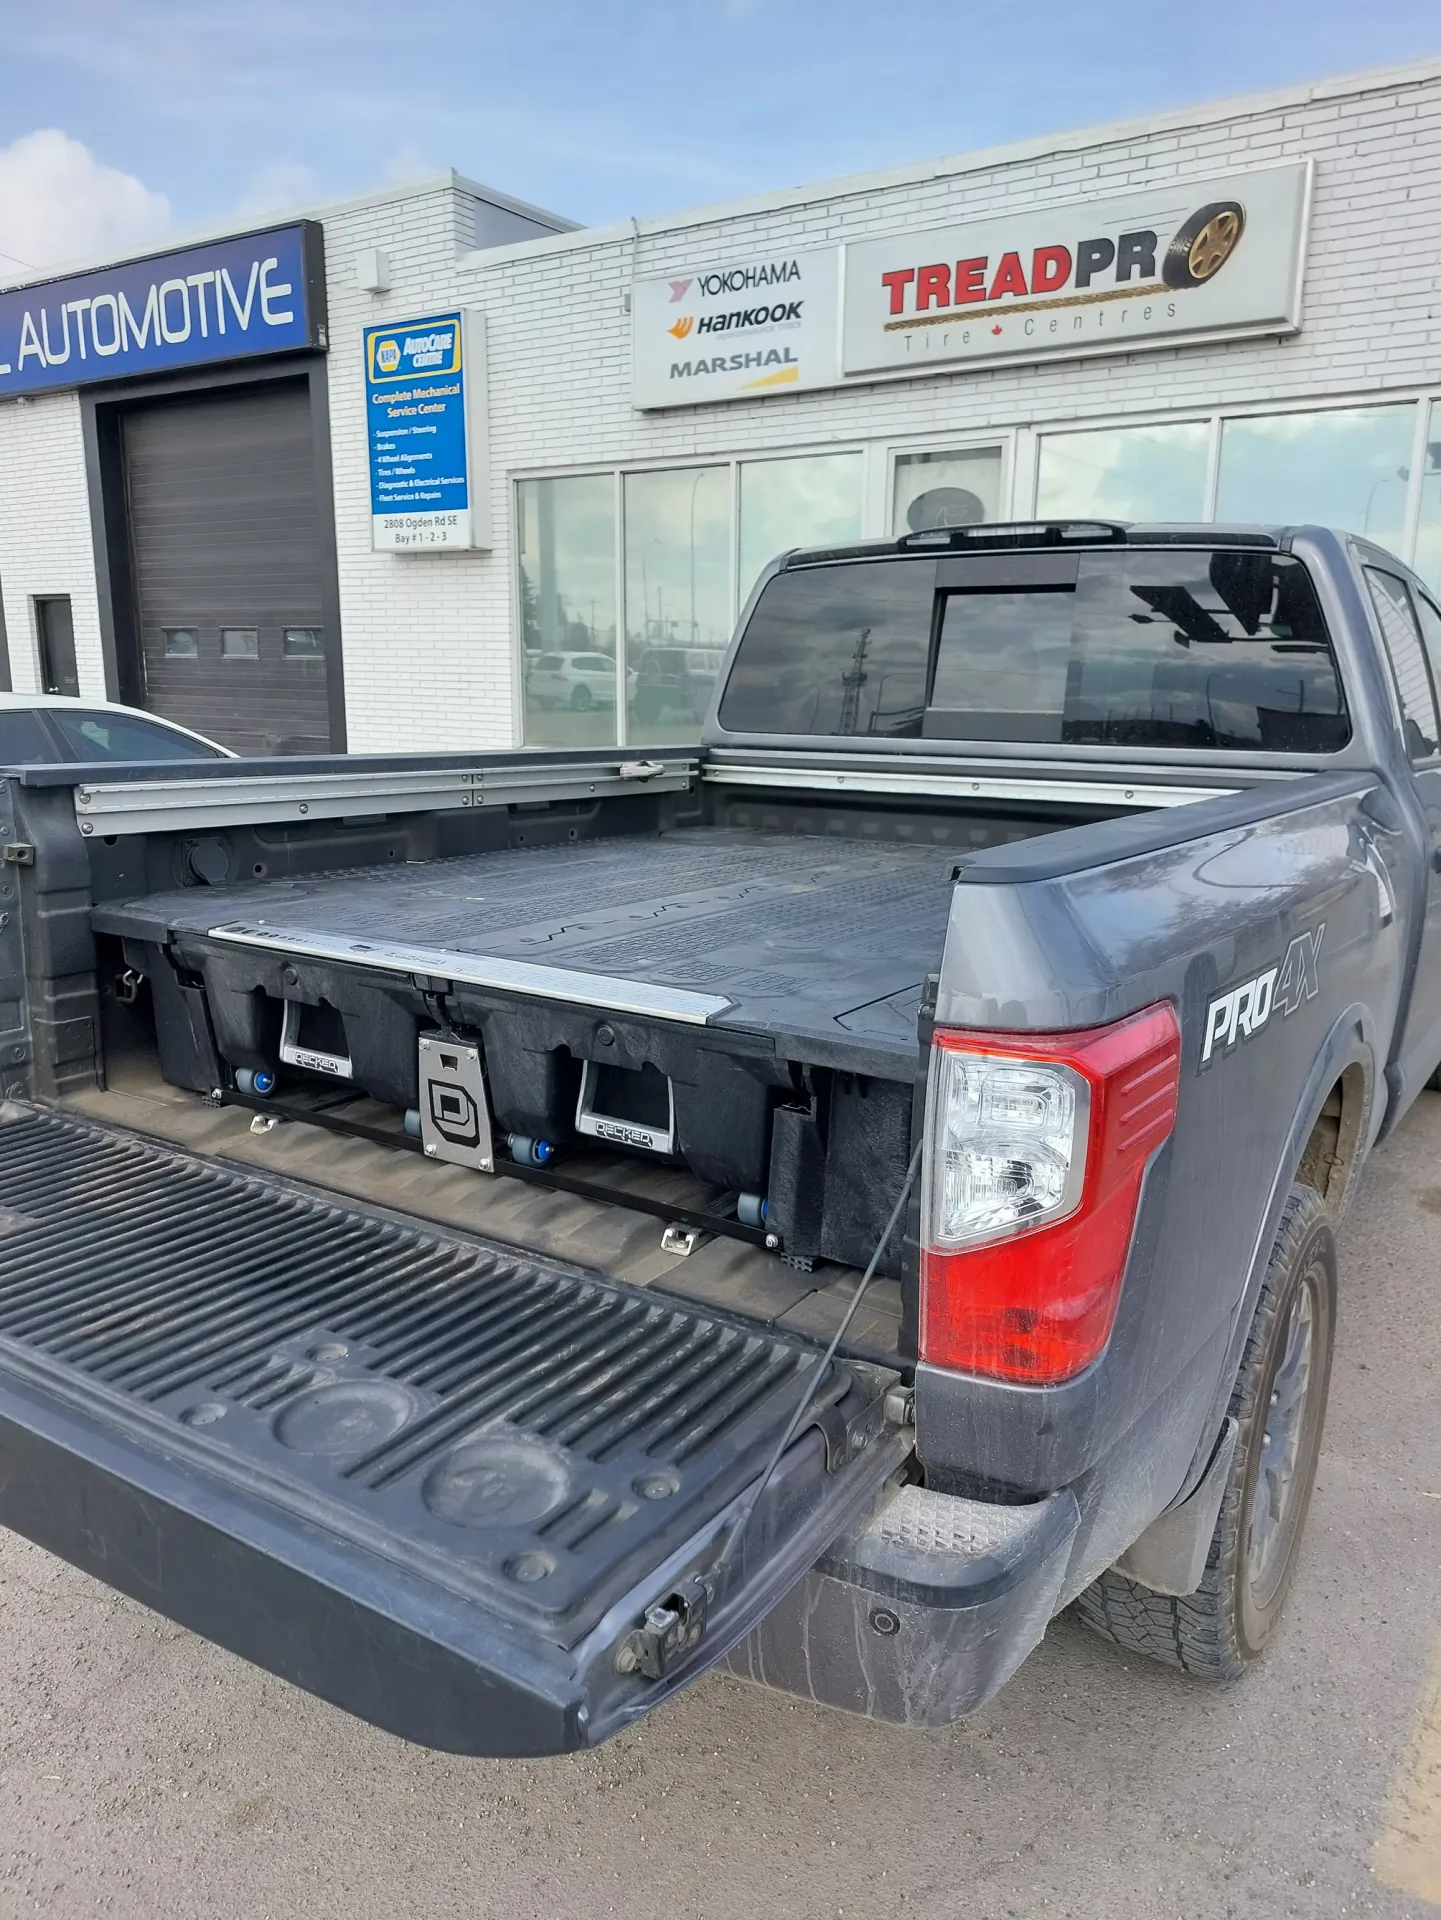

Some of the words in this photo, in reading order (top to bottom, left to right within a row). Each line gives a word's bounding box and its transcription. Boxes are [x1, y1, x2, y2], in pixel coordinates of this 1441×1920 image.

[697, 259, 801, 297] YOKOHAMA
[17, 257, 294, 372] AUTOMOTIVE
[903, 329, 970, 352] Tire
[1024, 302, 1176, 336] Centres
[381, 348, 397, 364] NAPA
[670, 347, 798, 379] MARSHAL
[372, 391, 412, 404] Complete
[413, 383, 460, 399] Mechanical
[387, 406, 417, 418] Service
[418, 403, 446, 414] Center
[393, 492, 414, 501] Service
[384, 519, 404, 529] 2808
[405, 516, 433, 530] Ogden
[434, 515, 446, 526] Rd
[447, 515, 458, 526] SE
[395, 533, 410, 545] Bay
[430, 532, 435, 542] 2
[441, 531, 447, 541] 3
[295, 1051, 339, 1073] DECKED
[596, 1121, 653, 1148] DECKED
